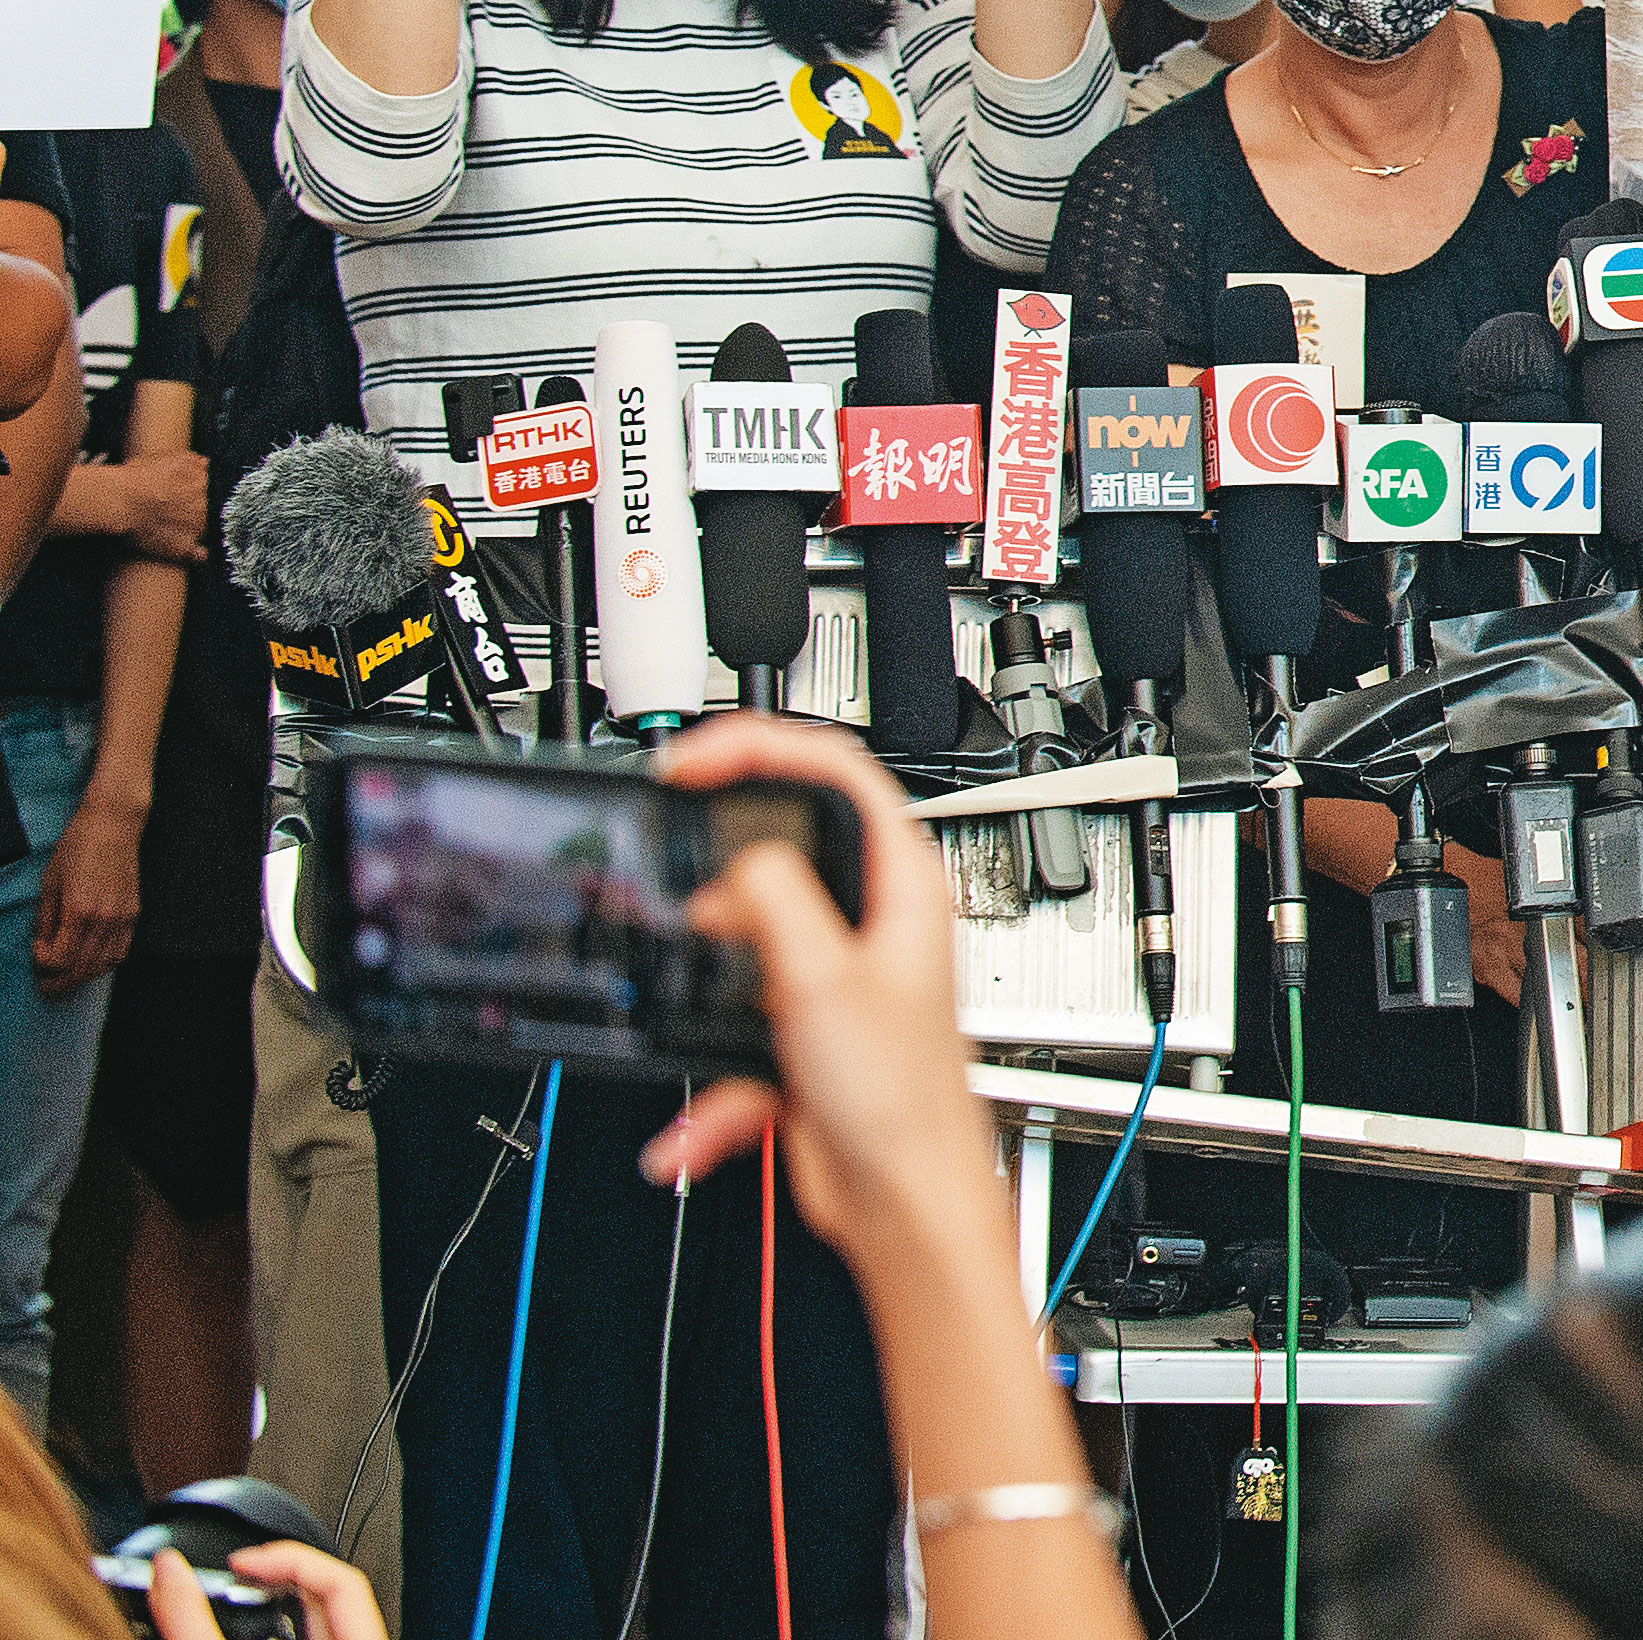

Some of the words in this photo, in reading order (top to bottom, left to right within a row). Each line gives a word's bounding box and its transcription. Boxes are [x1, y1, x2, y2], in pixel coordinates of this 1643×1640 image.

[493, 419, 584, 453] RTHK
[703, 408, 826, 449] TMHK
[1086, 414, 1191, 449] now
[493, 459, 591, 494] 香港電台
[618, 385, 651, 535] REUTERS
[705, 452, 735, 464] TRUTH
[739, 452, 769, 464] MEDIA
[772, 452, 798, 464] HONG
[802, 453, 827, 464] KONG
[990, 341, 1063, 582] 香港高登
[1089, 470, 1195, 508] 新聞台
[1361, 469, 1428, 499] RFA
[1474, 445, 1502, 511] 香港
[443, 571, 510, 684] 商台
